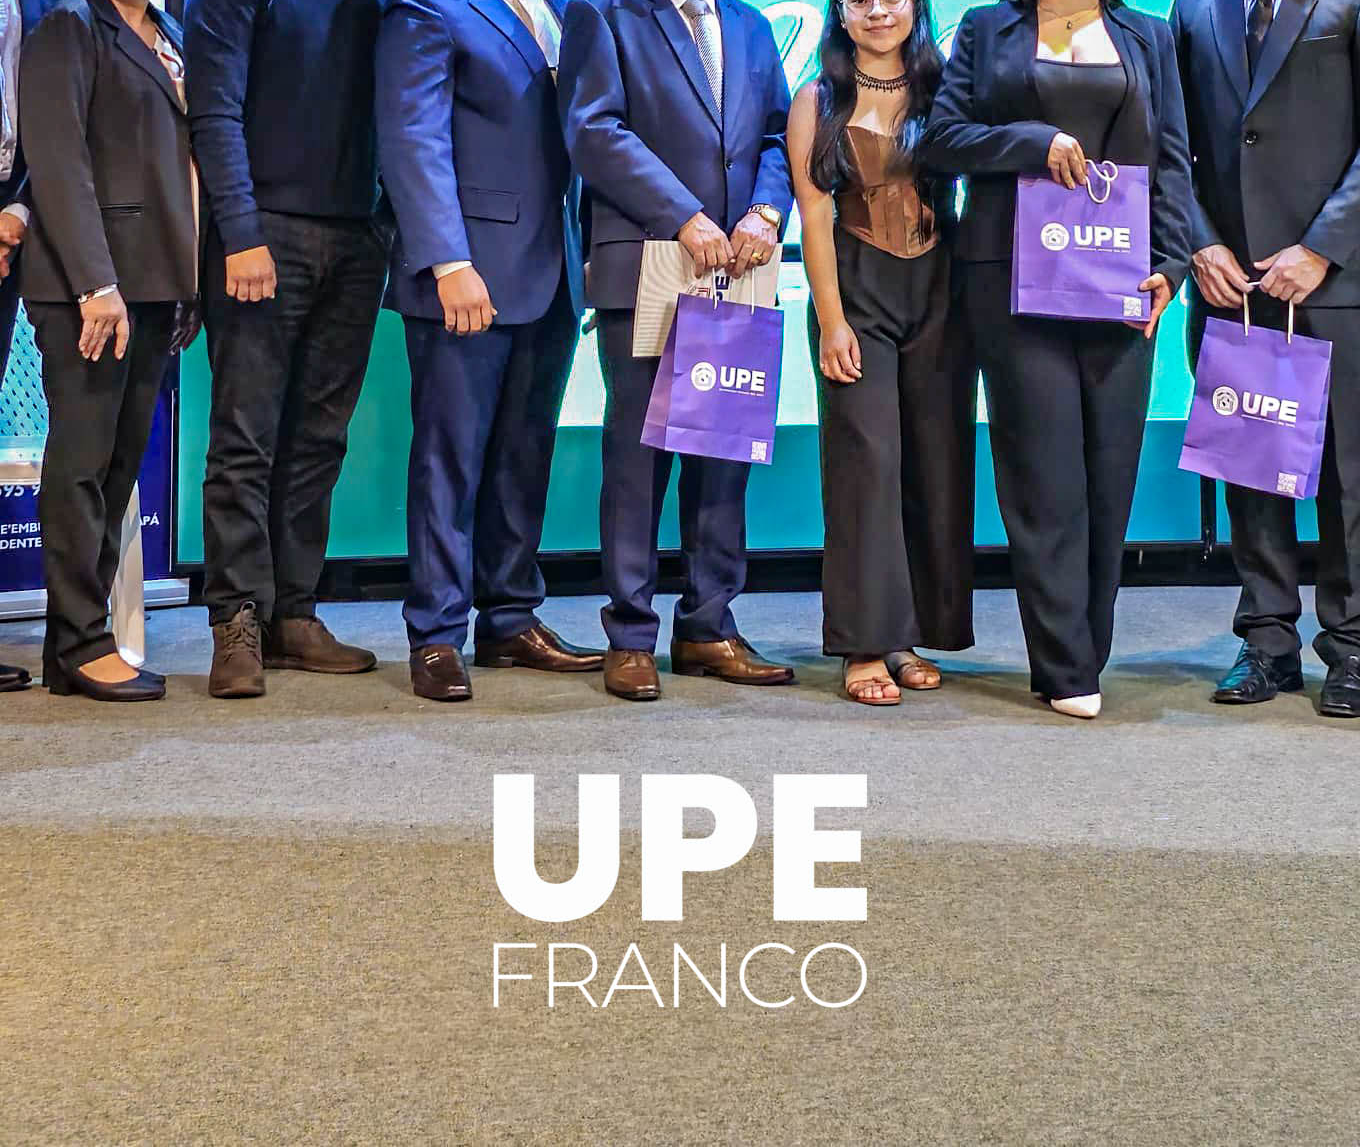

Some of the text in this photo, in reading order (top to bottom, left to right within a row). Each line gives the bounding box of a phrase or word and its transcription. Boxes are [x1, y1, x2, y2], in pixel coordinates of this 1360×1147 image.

[1073, 225, 1132, 249] UPE
[719, 365, 767, 392] UPE
[1241, 390, 1300, 423] UPE
